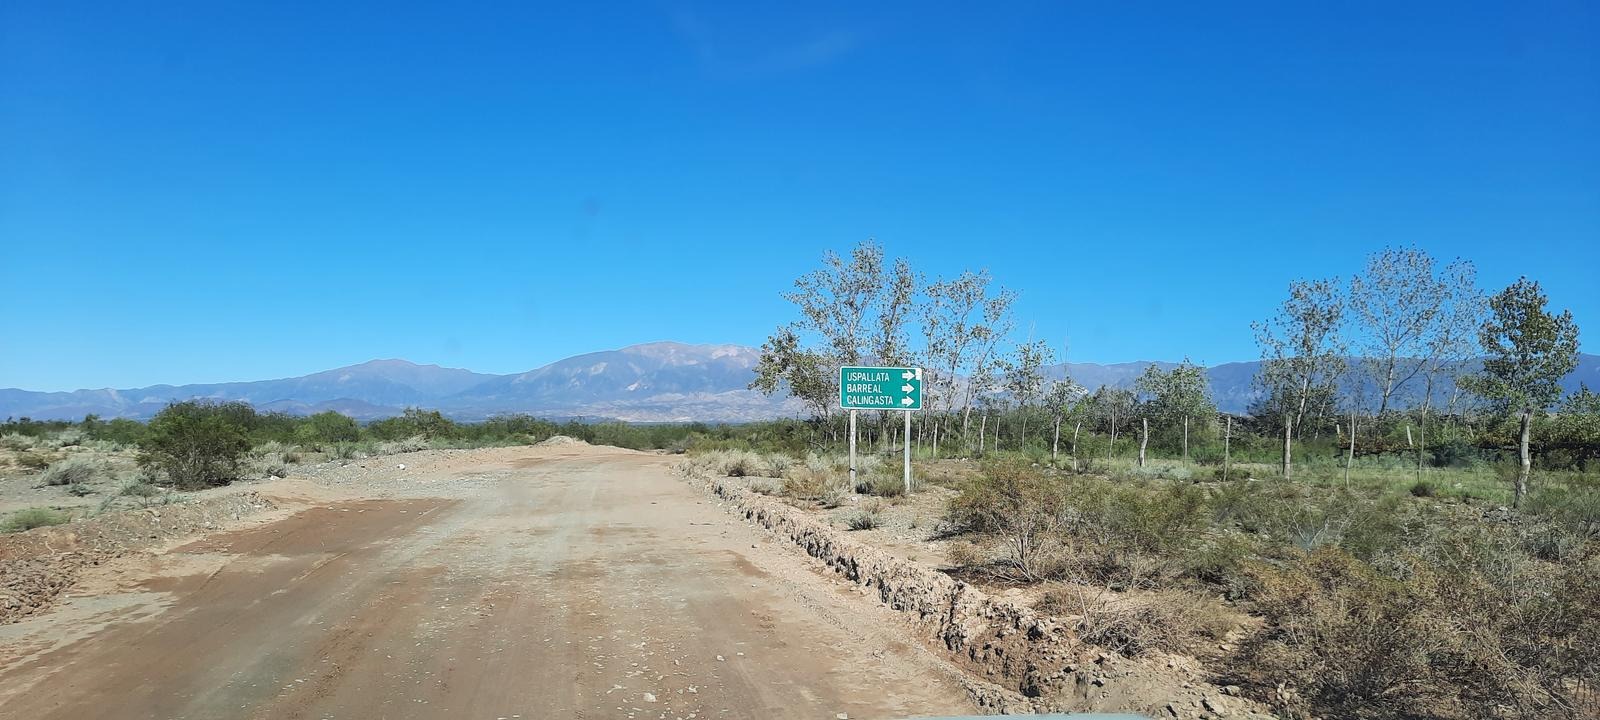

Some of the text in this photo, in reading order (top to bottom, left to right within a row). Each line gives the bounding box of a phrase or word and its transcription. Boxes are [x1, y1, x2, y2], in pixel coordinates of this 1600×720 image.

[847, 372, 890, 382] USPALLATA
[846, 383, 882, 393] BARREAL
[846, 395, 894, 405] CALINGASTA
